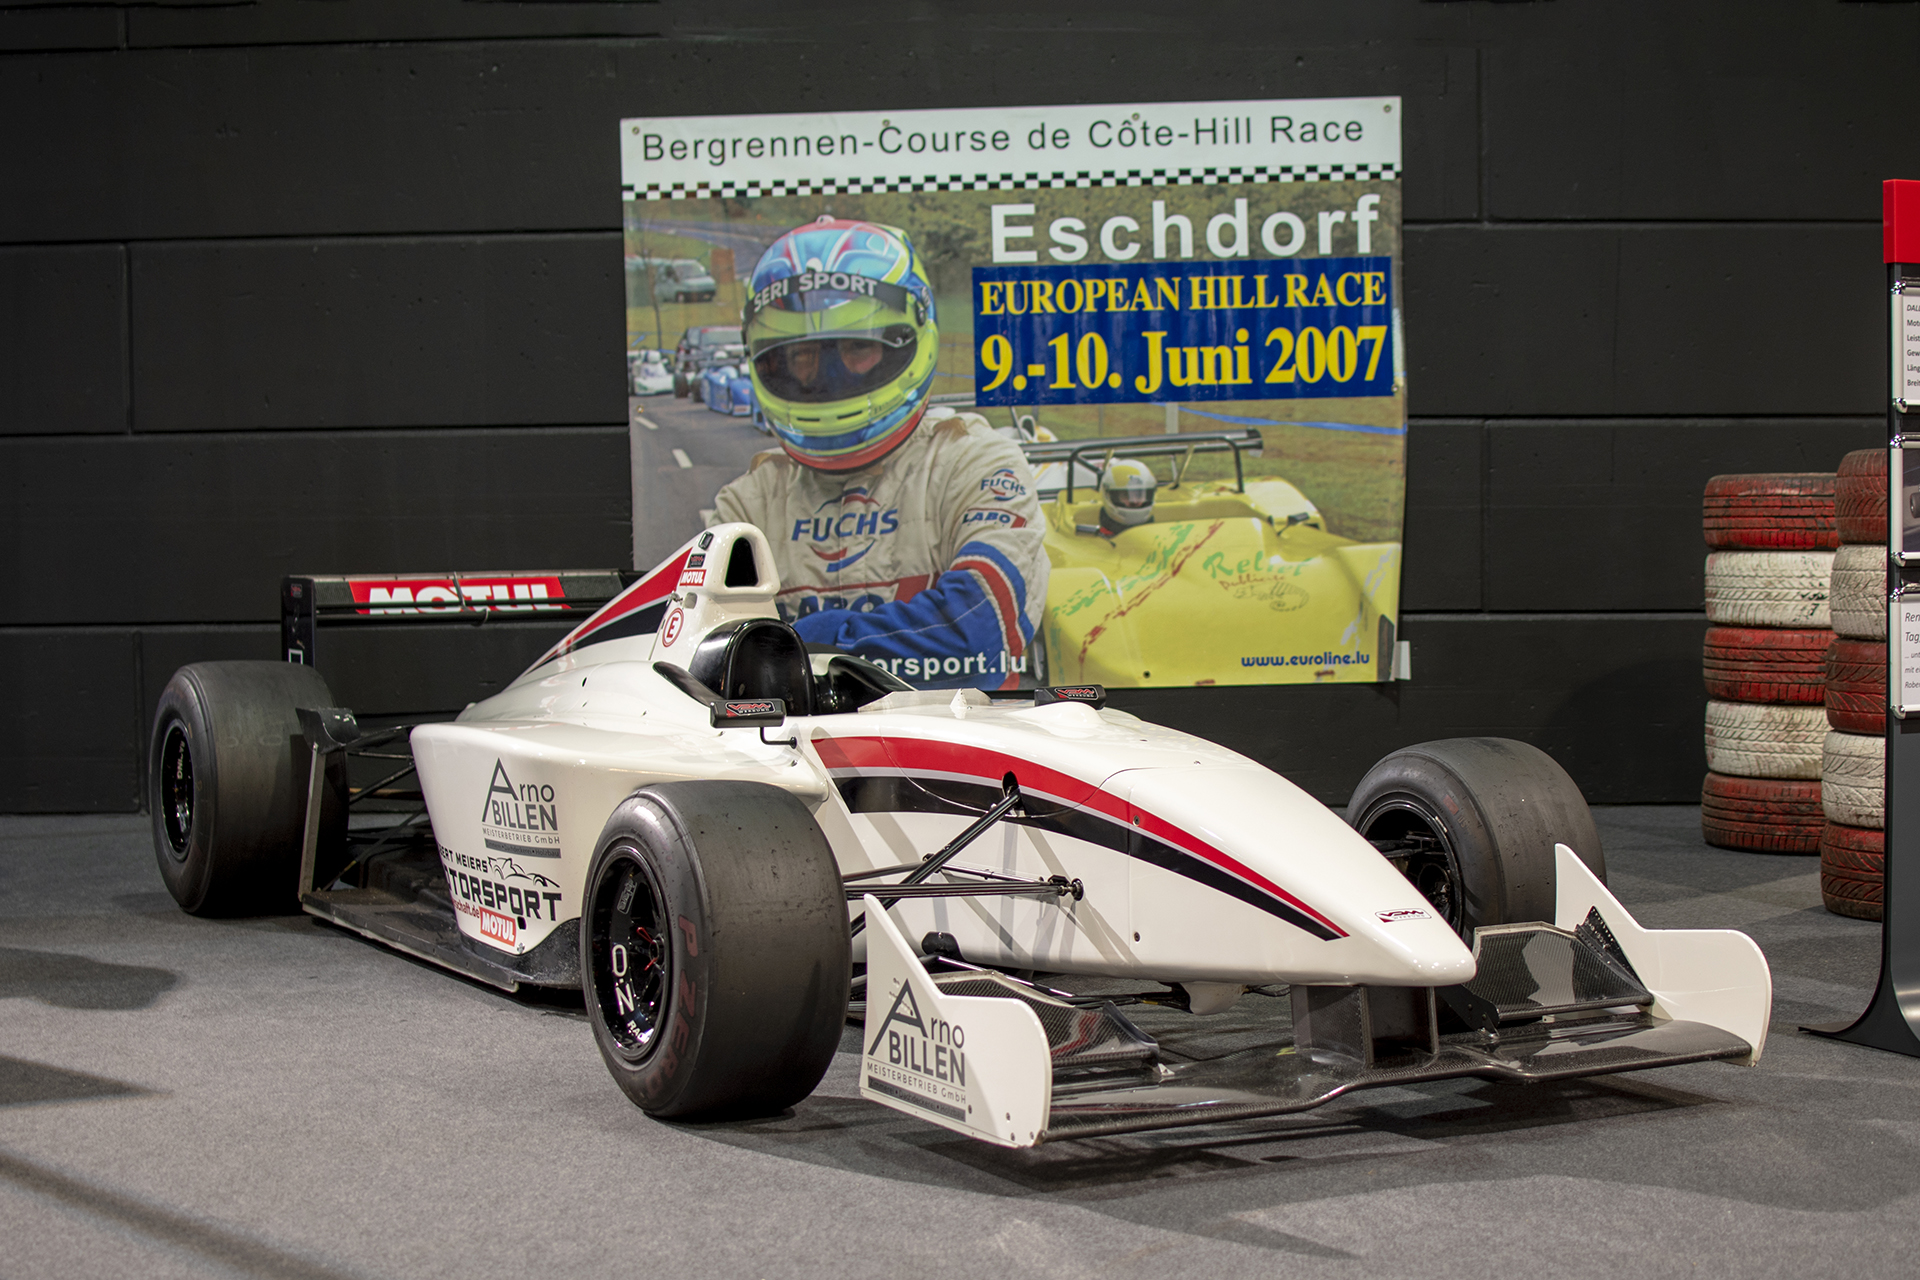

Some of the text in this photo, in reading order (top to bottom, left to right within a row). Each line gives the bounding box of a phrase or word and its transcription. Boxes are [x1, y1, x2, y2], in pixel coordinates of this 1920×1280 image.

[643, 115, 1364, 166] Bergrennen-Course de Côte-Hill Race
[991, 194, 1381, 264] Eschdorf
[754, 271, 878, 313] SERI SPORT
[979, 271, 1387, 315] EUROPEAN HILL RACE
[981, 325, 1388, 394] 9.-10. Juni 2007
[981, 478, 1026, 495] FUCHS
[791, 508, 899, 542] FUCHS
[962, 512, 1011, 525] LABO
[680, 570, 705, 585] MOTUL
[369, 583, 563, 615] MOTUL
[666, 617, 680, 639] E
[861, 653, 1028, 681] orsport.lu
[1241, 651, 1370, 668] www.euroline.lu
[482, 757, 555, 822] Arno
[491, 800, 559, 831] BILLEN
[482, 827, 561, 845] MEISTERBETRIEB GmbH
[455, 852, 489, 873] MEIERS
[481, 913, 516, 942] MOTUL
[867, 977, 965, 1057] Arno
[888, 1030, 966, 1087] BILLEN
[867, 1061, 967, 1105] MEISTERBETRIEB GmbH
